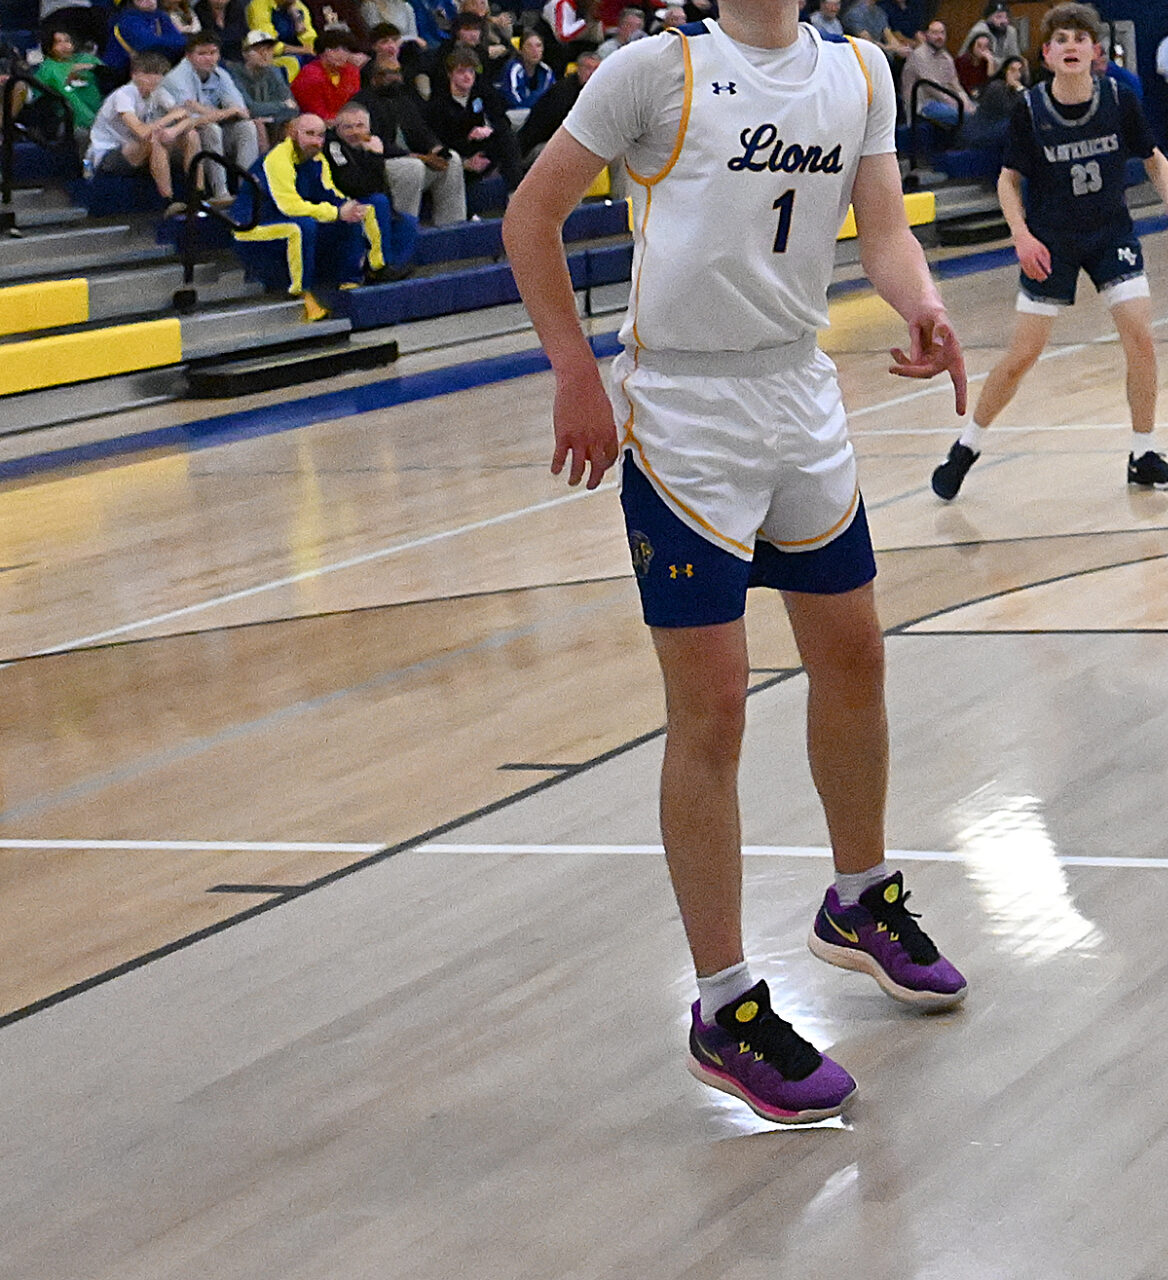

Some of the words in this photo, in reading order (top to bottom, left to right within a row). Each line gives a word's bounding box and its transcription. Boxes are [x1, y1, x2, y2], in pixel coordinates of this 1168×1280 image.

[728, 123, 843, 175] Lions
[1071, 160, 1103, 196] 23
[772, 188, 796, 254] 1
